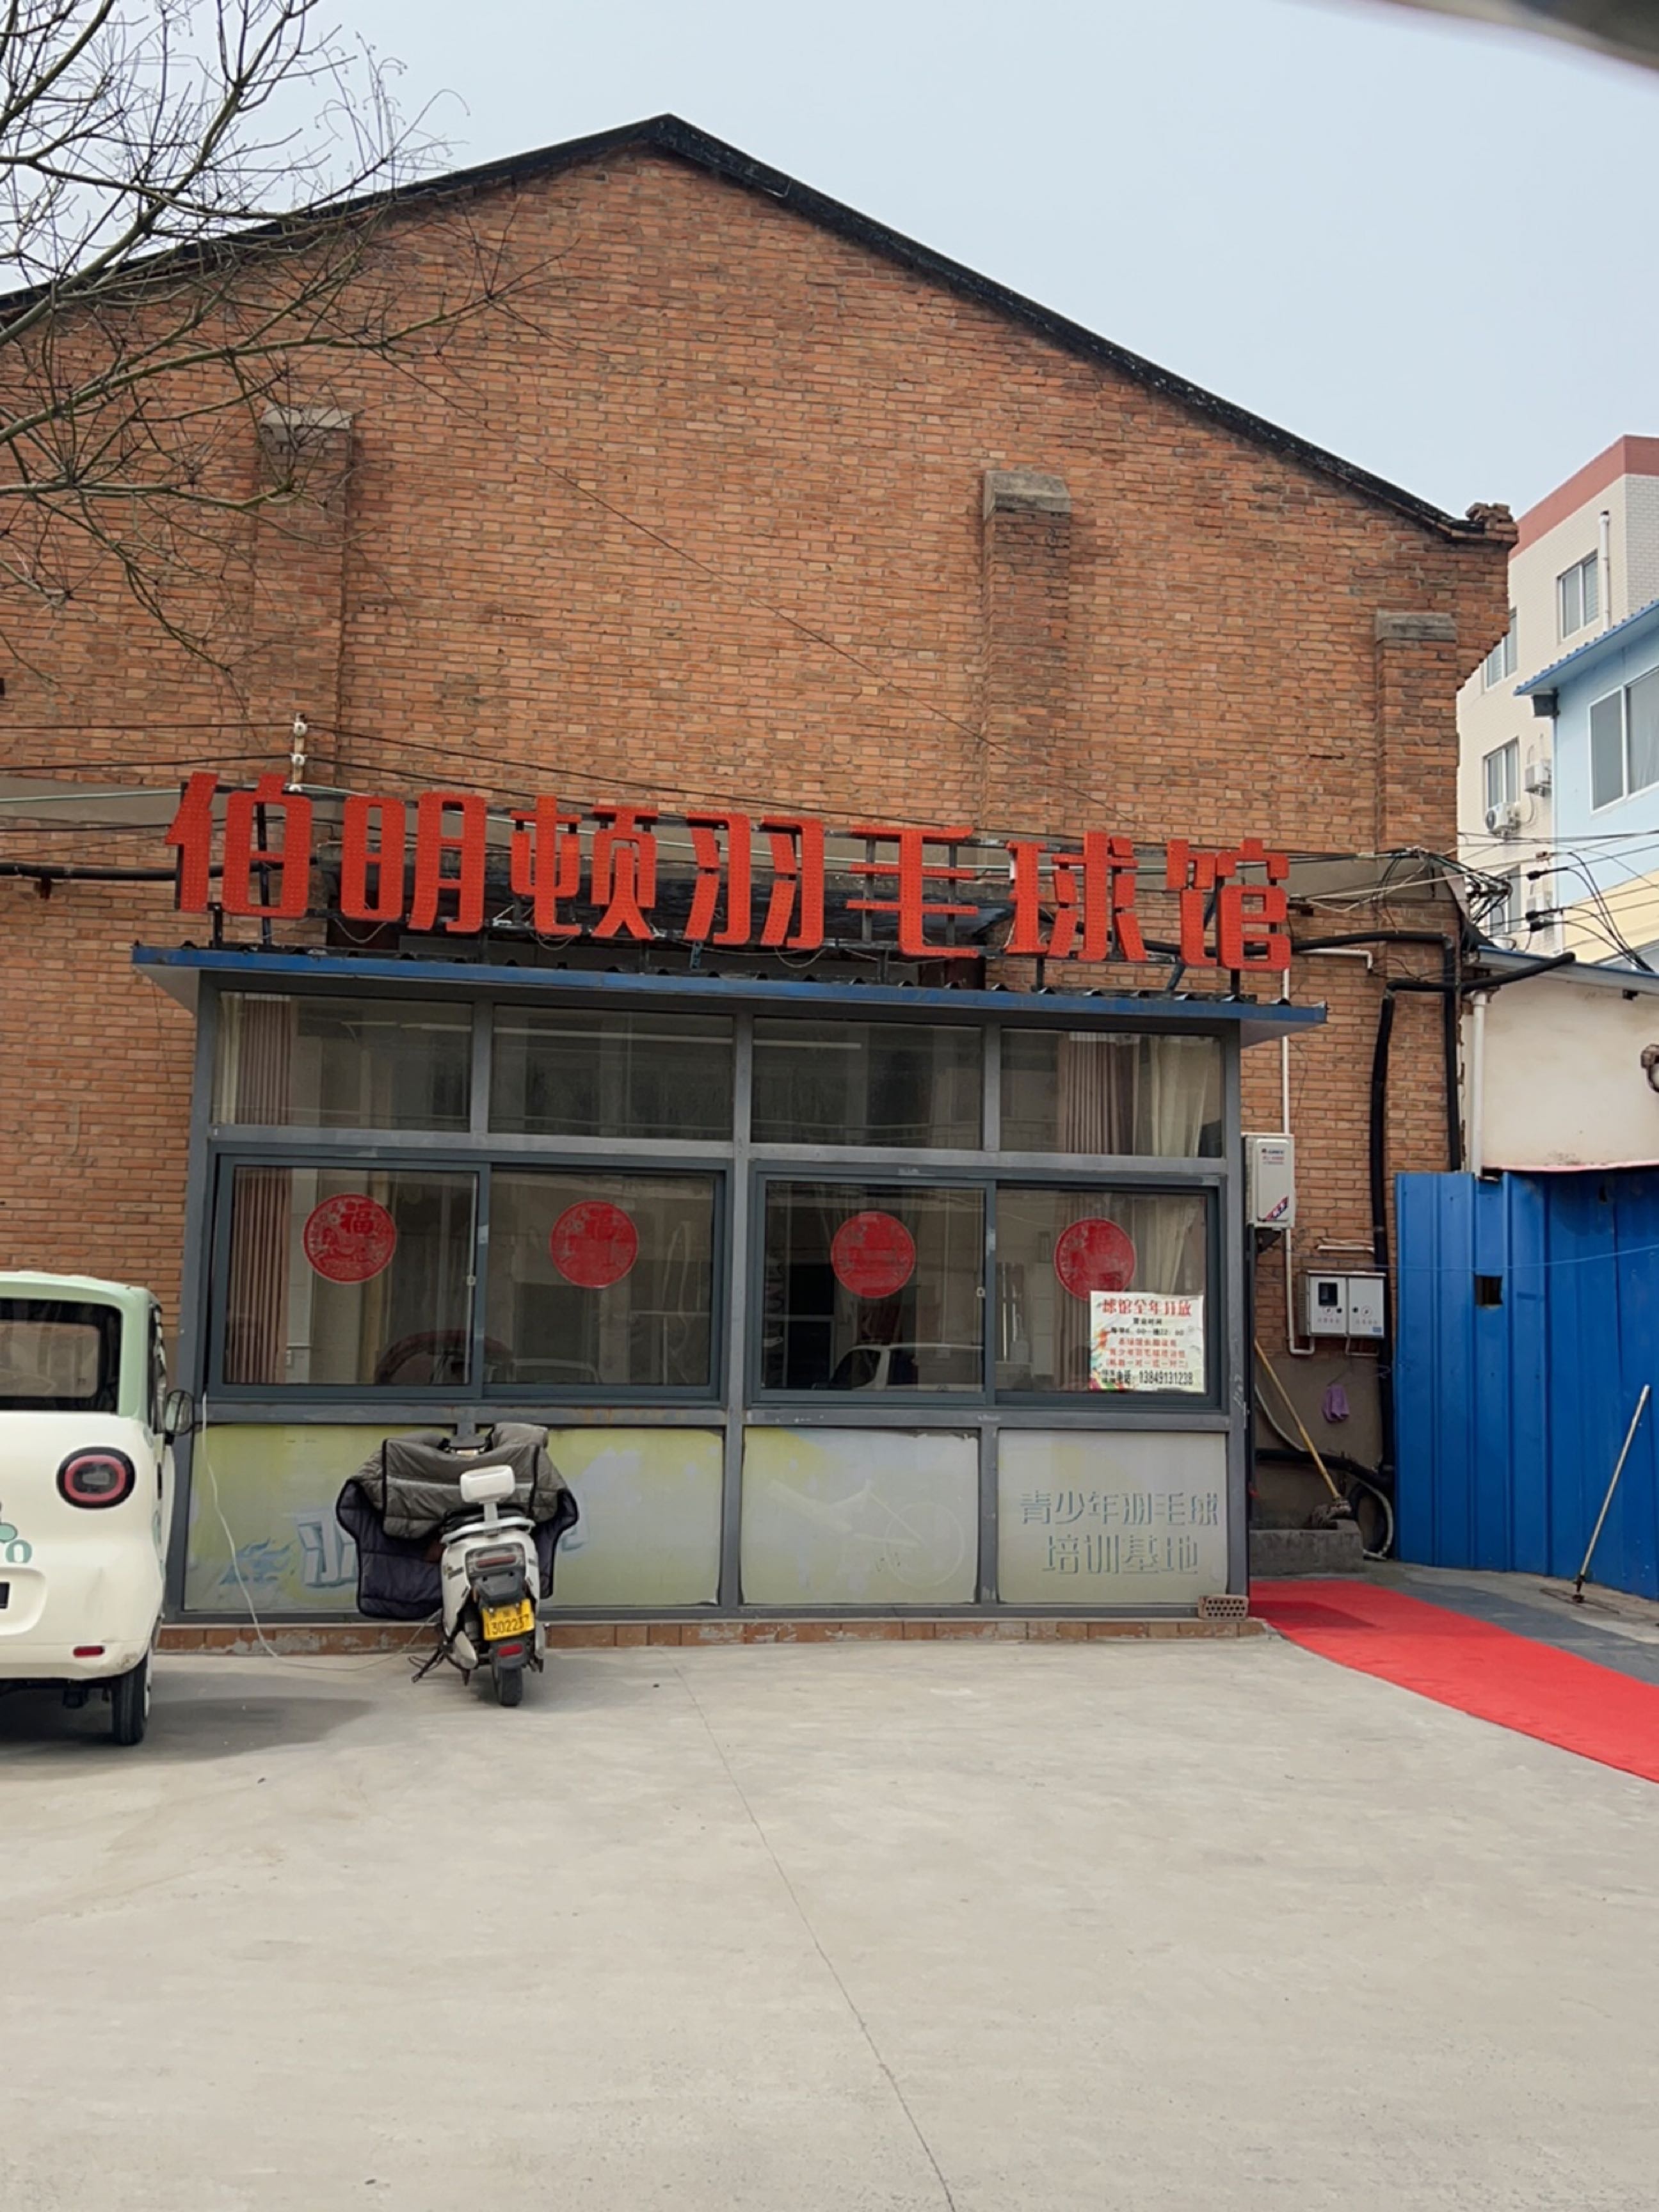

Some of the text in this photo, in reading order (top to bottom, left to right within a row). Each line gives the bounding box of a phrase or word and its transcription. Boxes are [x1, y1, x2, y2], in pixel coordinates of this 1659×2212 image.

[165, 772, 1292, 971] 伯明顿羽毛球馆
[340, 1201, 374, 1235] 福
[1020, 1490, 1218, 1526] 青少年羽毛球
[1042, 1534, 1199, 1575] 培训基地
